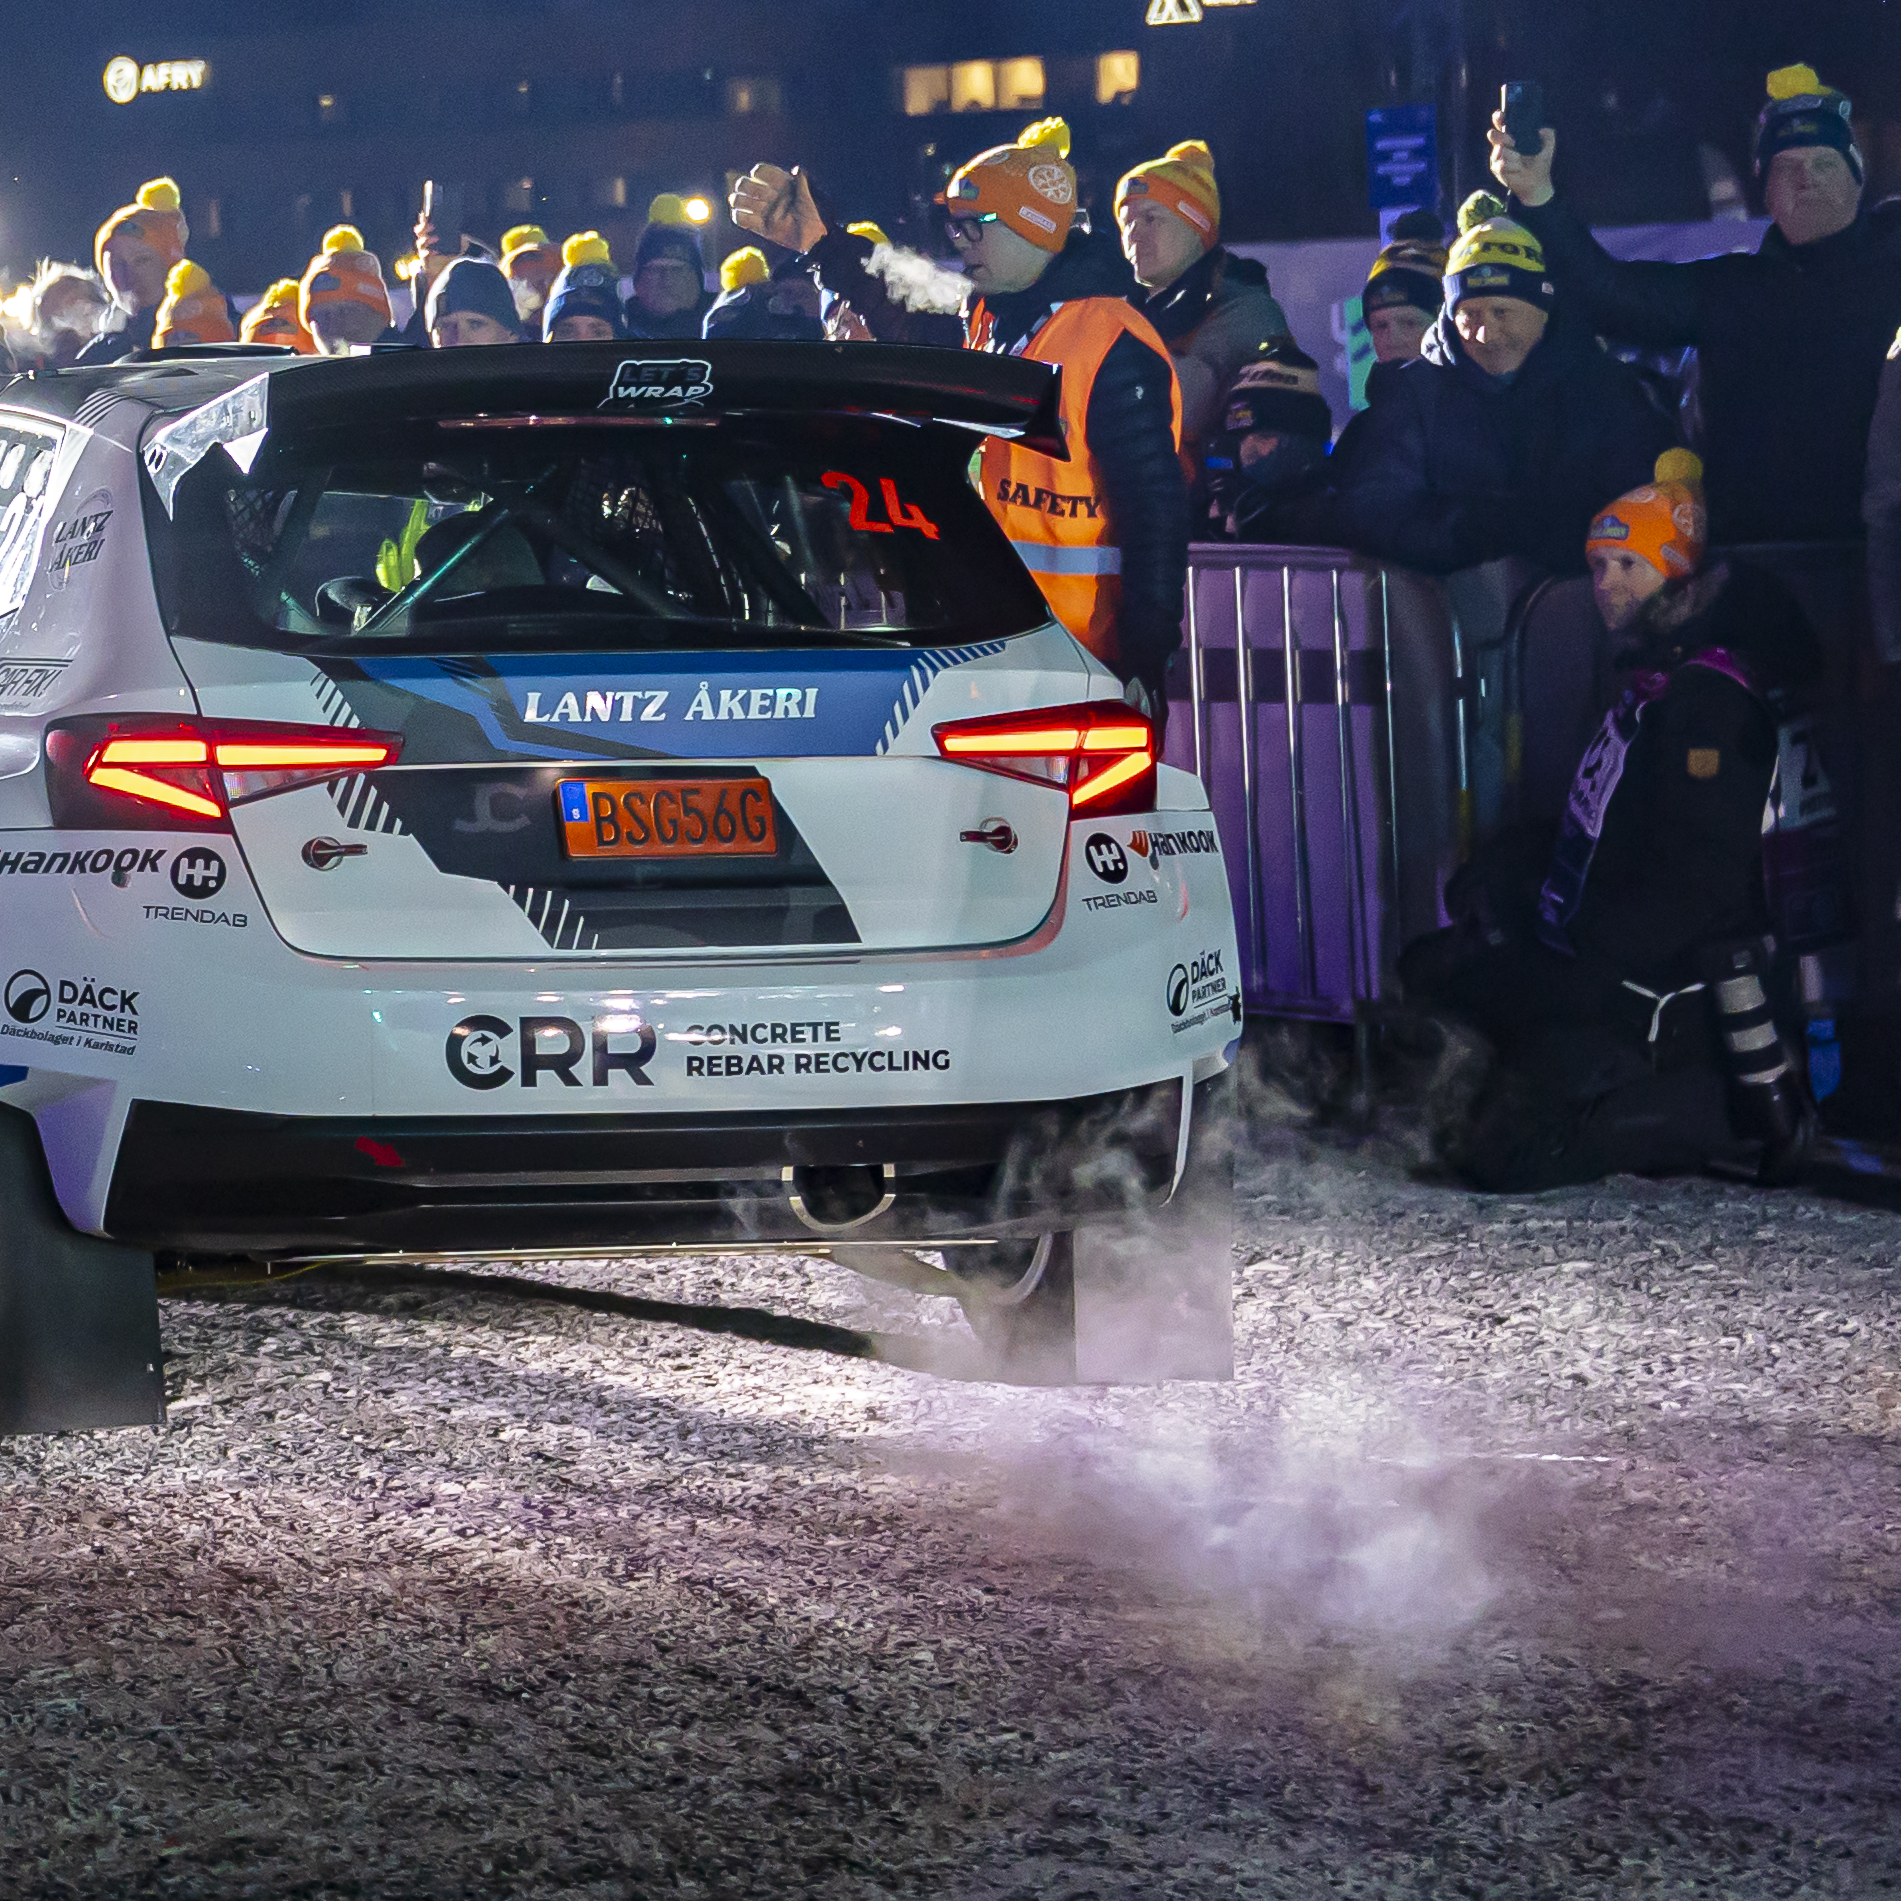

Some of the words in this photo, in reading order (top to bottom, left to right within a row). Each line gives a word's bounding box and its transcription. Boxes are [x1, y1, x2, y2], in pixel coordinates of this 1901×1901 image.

[139, 59, 206, 93] AFRY
[617, 386, 705, 398] WRAP
[821, 471, 941, 540] 24
[998, 478, 1099, 518] SAFETY
[54, 509, 114, 544] LANTZ
[523, 690, 669, 723] LANTZ
[683, 680, 820, 721] ÅKERI
[591, 788, 768, 848] BSG56G
[142, 905, 249, 928] TRENDAB
[1081, 889, 1159, 912] TRENDAB
[1190, 948, 1224, 986] DÄCK
[58, 976, 140, 1017] DÄCK
[56, 1007, 139, 1036] PARTNER
[686, 1020, 842, 1047] CONCRETE
[83, 1037, 138, 1056] Karlstad
[445, 1013, 658, 1091] CRR
[685, 1052, 786, 1077] REBAR
[794, 1049, 952, 1075] RECYCLING
